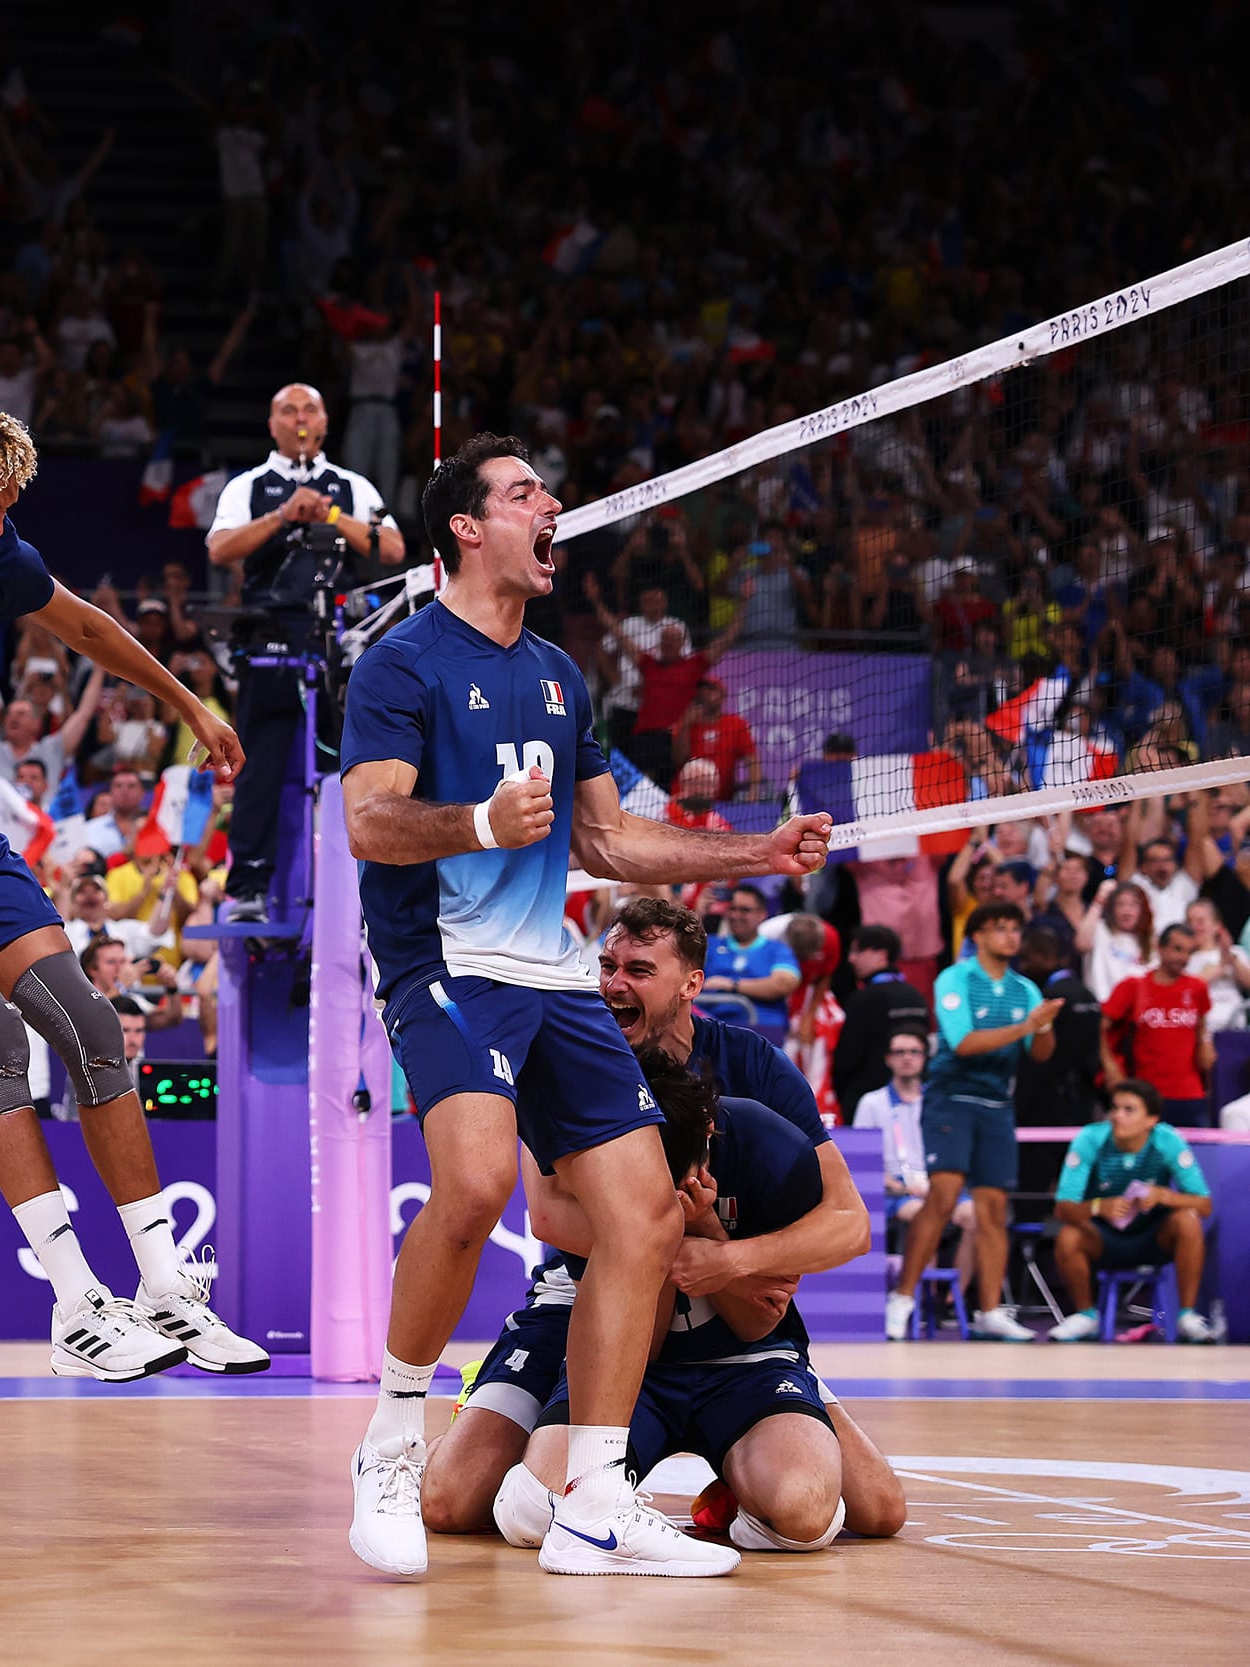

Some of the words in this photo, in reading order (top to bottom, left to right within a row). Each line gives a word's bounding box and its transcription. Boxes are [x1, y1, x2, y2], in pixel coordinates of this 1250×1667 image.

[1105, 286, 1151, 326] 2024
[545, 703, 567, 716] FRA
[489, 1048, 515, 1086] 19
[504, 1349, 530, 1372] 4
